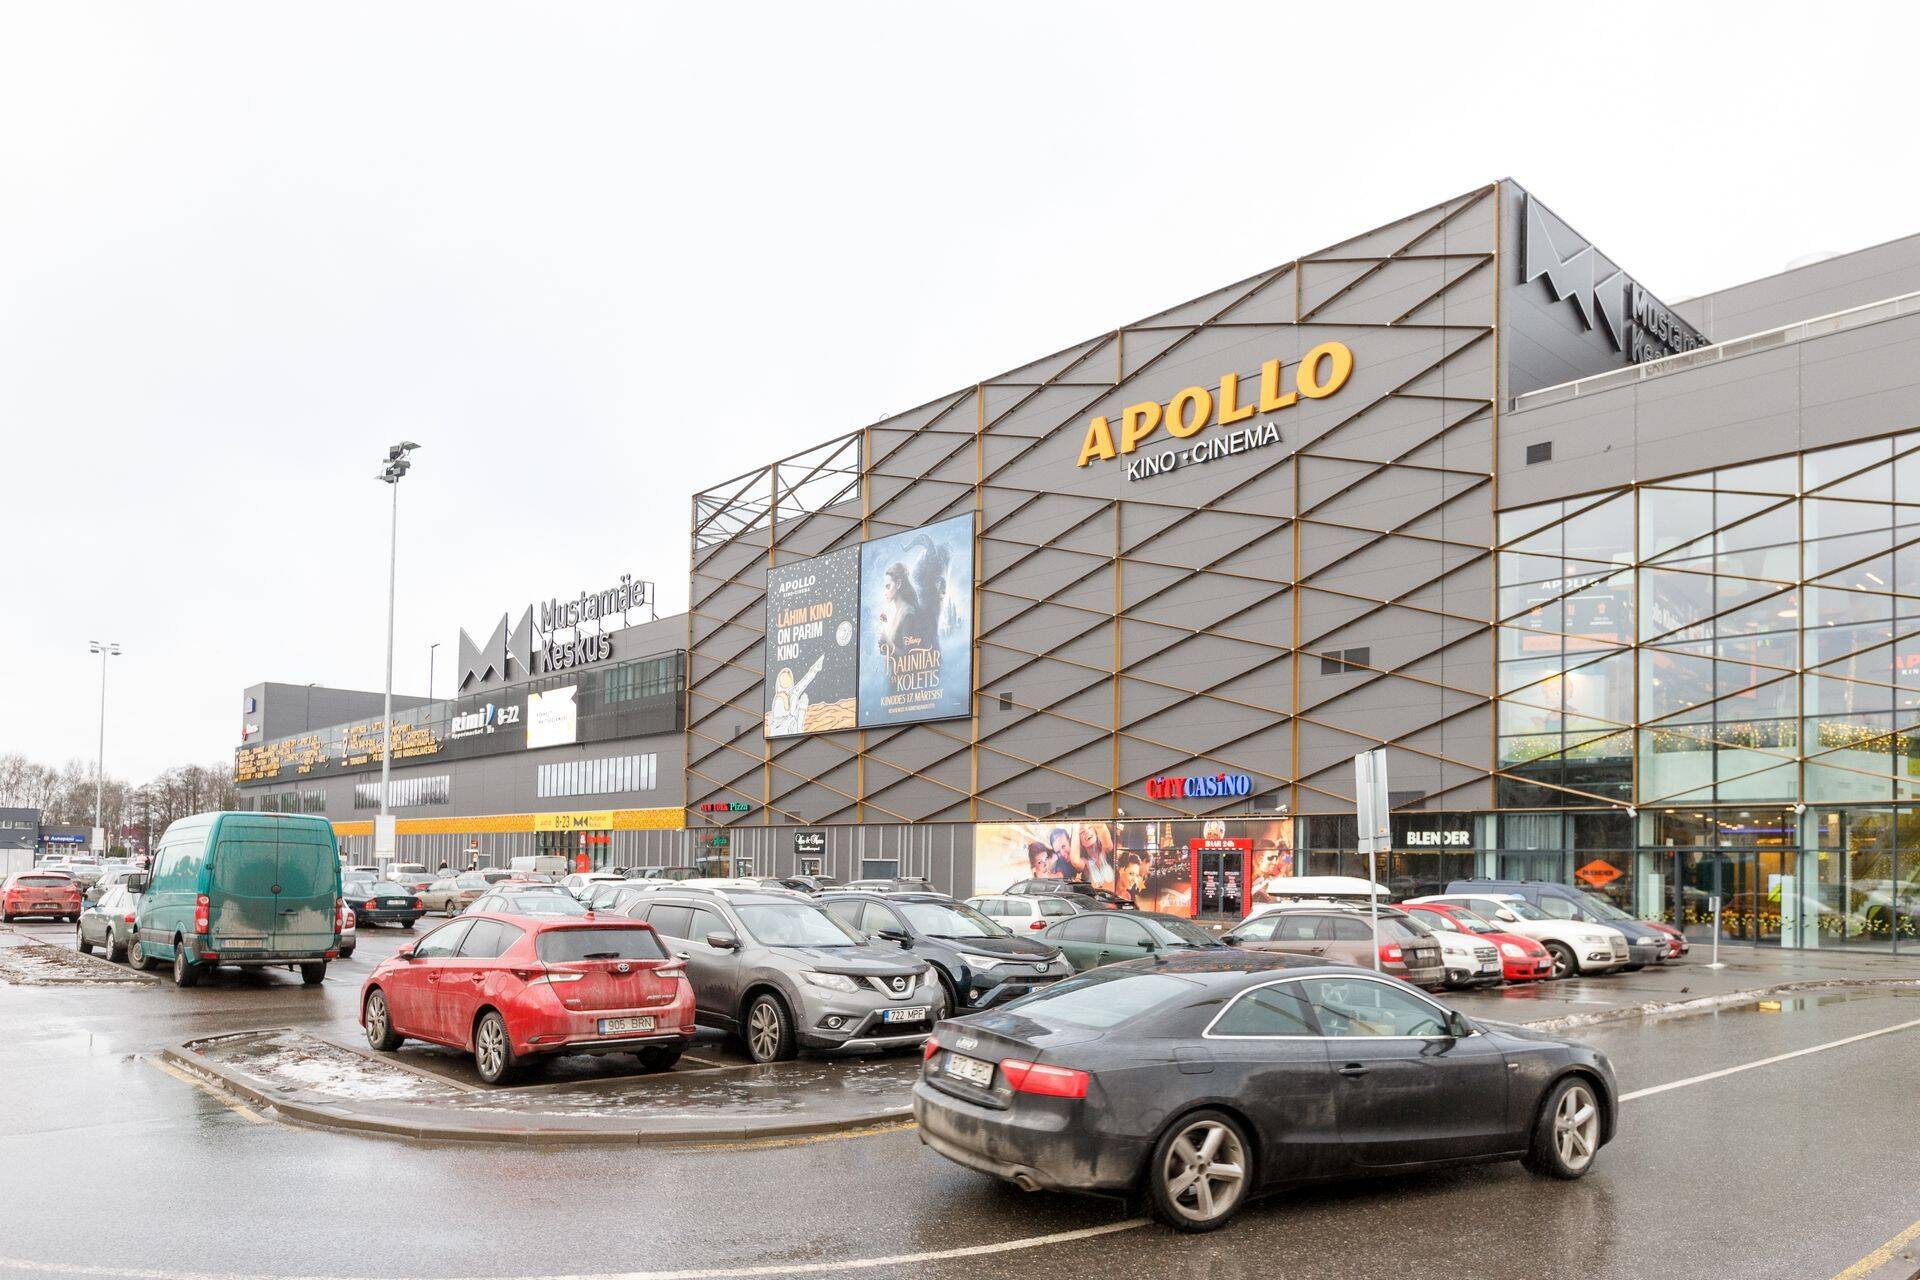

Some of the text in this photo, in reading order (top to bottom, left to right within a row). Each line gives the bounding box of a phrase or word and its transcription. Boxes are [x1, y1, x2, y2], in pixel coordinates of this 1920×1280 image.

[1076, 341, 1354, 467] APOLLO
[1127, 421, 1281, 482] KINO CINEMA
[779, 575, 816, 593] APOLLO
[541, 573, 645, 634] Mustamäe
[777, 601, 833, 628] LÄHIM KINO
[777, 621, 823, 645] ON PARIM
[541, 631, 611, 673] Keskus
[777, 643, 799, 661] KINO
[897, 669, 940, 692] KOLETIS
[497, 705, 520, 725] 8-22
[555, 815, 570, 828] 8-23
[1407, 831, 1470, 845] BLENDER
[608, 1017, 652, 1031] 905 BRN
[891, 1010, 905, 1021] 722
